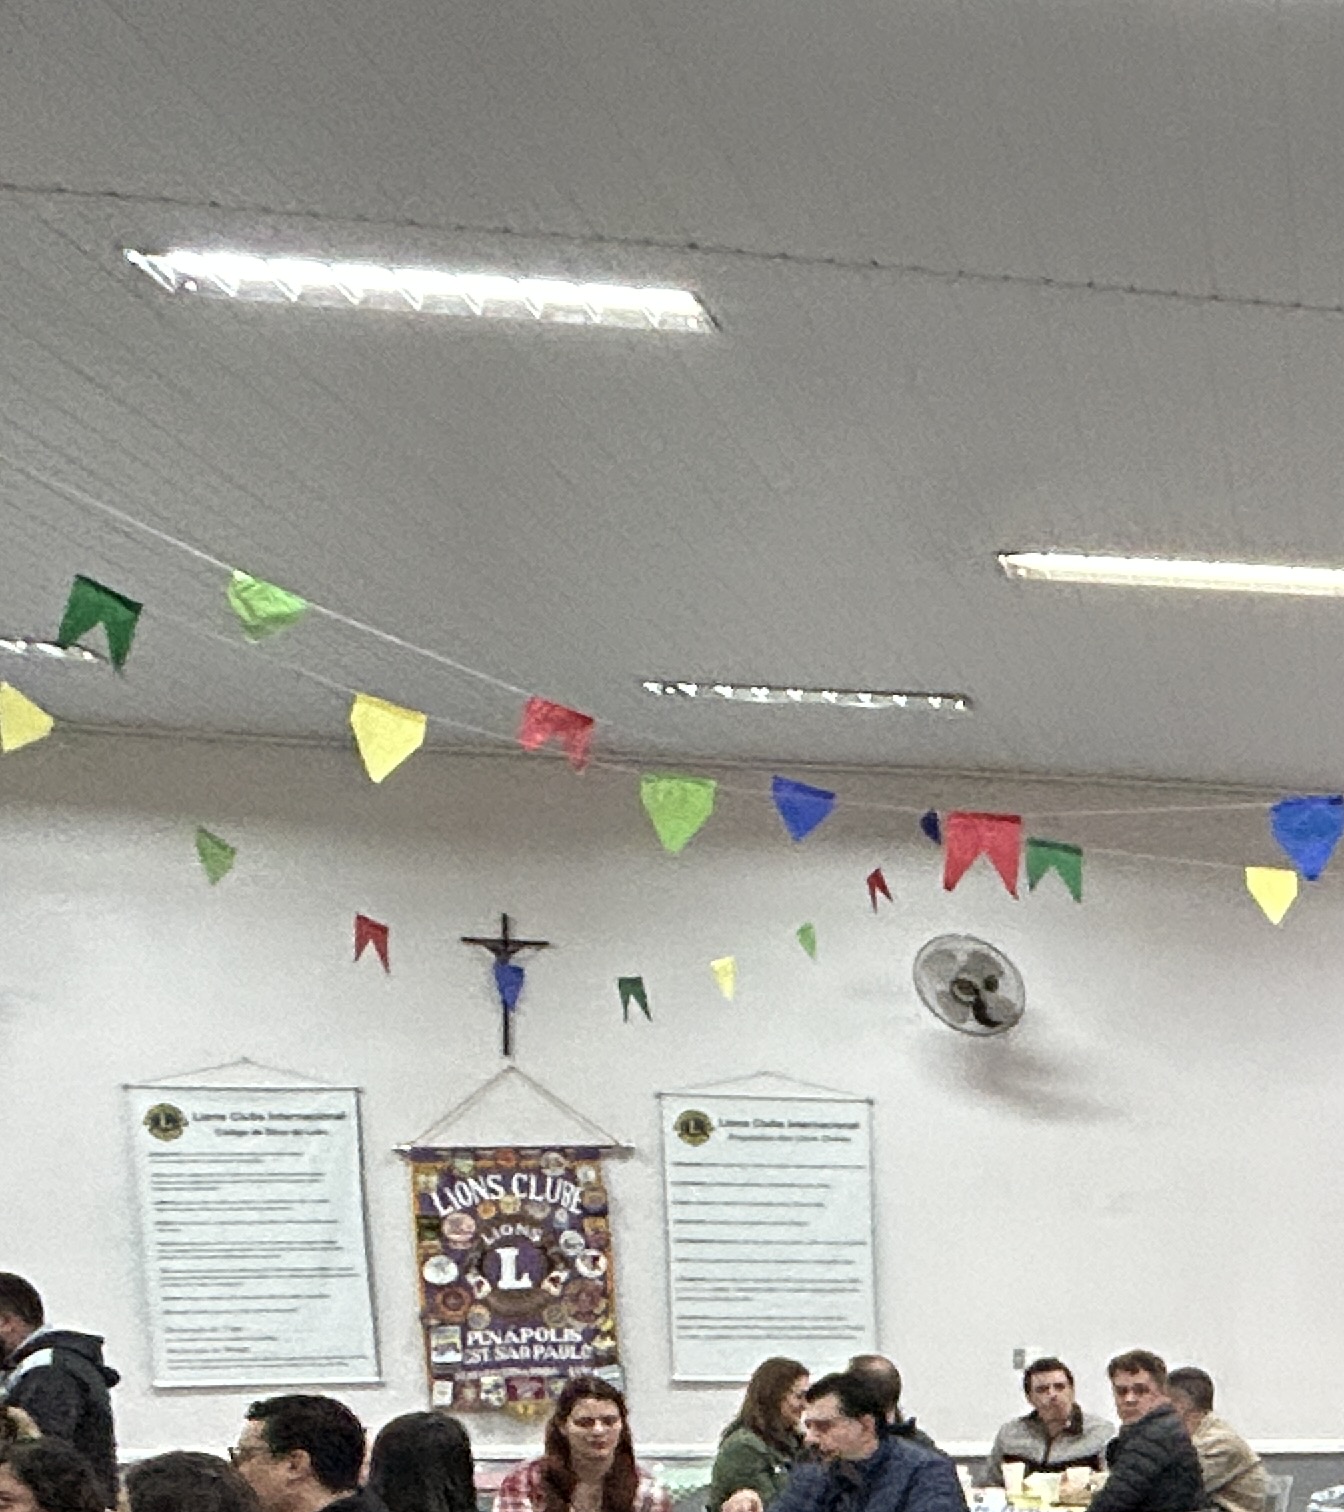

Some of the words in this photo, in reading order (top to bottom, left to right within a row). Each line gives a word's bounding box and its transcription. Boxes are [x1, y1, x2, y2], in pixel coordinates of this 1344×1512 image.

[430, 1174, 506, 1217] LIONS
[510, 1172, 583, 1214] CLUBE
[481, 1222, 544, 1246] LIONS
[495, 1246, 533, 1290] L
